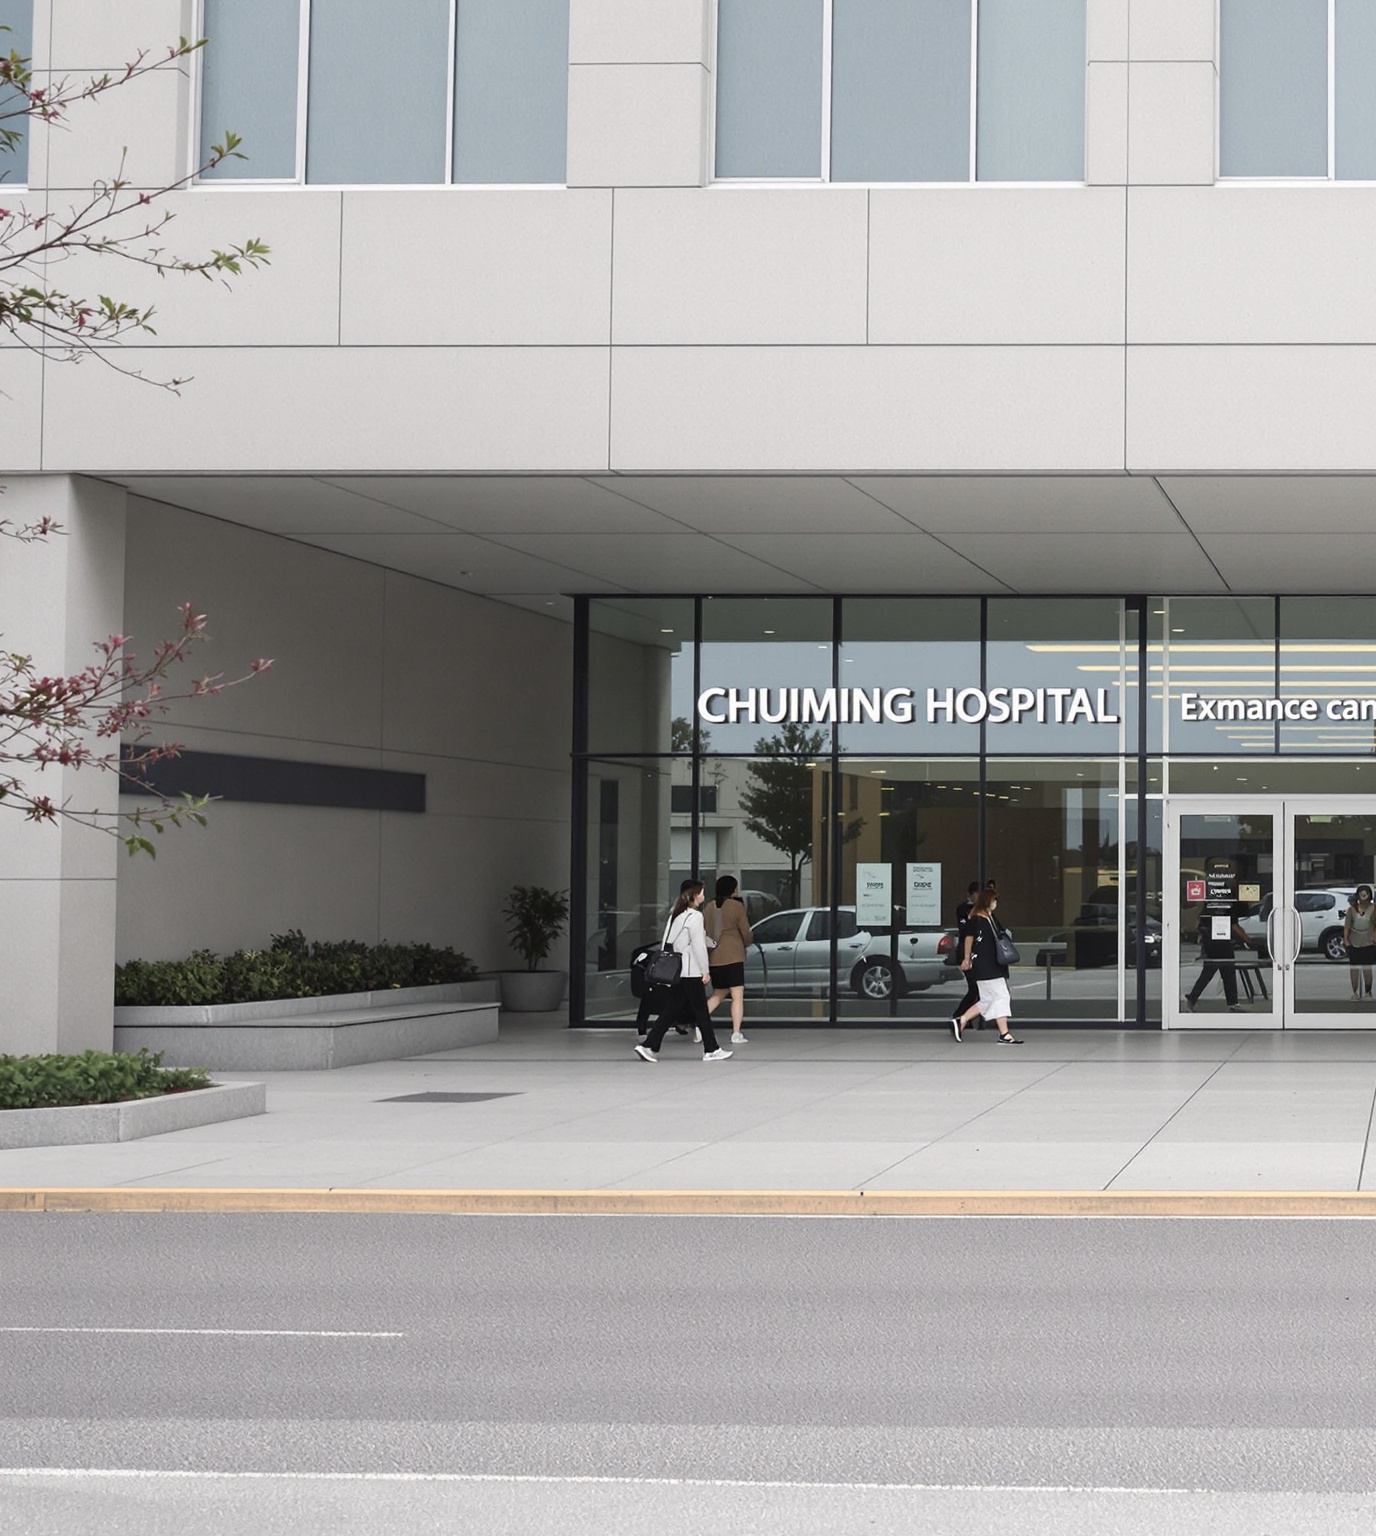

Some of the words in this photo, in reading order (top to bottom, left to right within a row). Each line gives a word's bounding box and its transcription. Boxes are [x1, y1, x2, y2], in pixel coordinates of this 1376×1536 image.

[698, 687, 912, 723] CHUIMING
[926, 687, 1118, 723] HOSPITAL
[1180, 692, 1318, 720] Exmance
